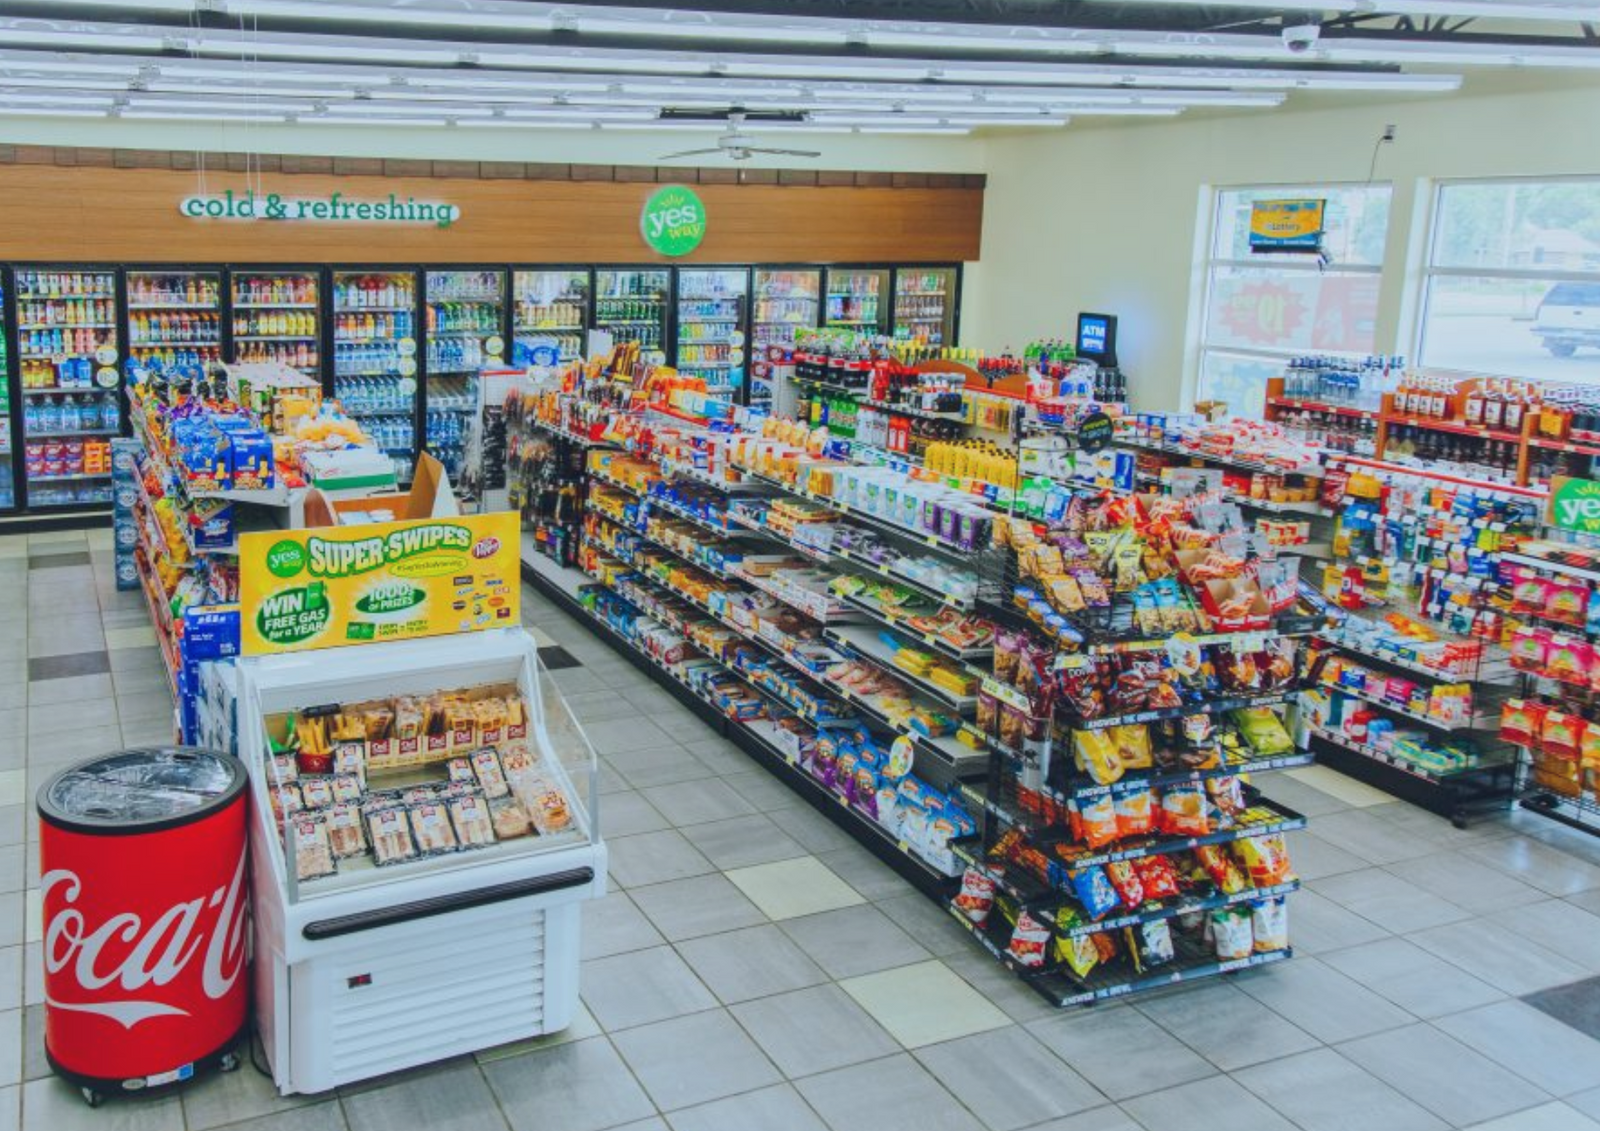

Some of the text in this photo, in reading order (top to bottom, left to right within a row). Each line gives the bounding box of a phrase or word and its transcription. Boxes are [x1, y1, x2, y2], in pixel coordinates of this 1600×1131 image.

[187, 190, 453, 229] cold & refreshing
[648, 204, 698, 239] yes
[1082, 325, 1106, 338] ATM
[271, 550, 300, 568] yes
[262, 592, 303, 617] WIN
[380, 597, 413, 610] PRIZES
[265, 609, 326, 631] FREE GAS
[269, 630, 283, 641] for
